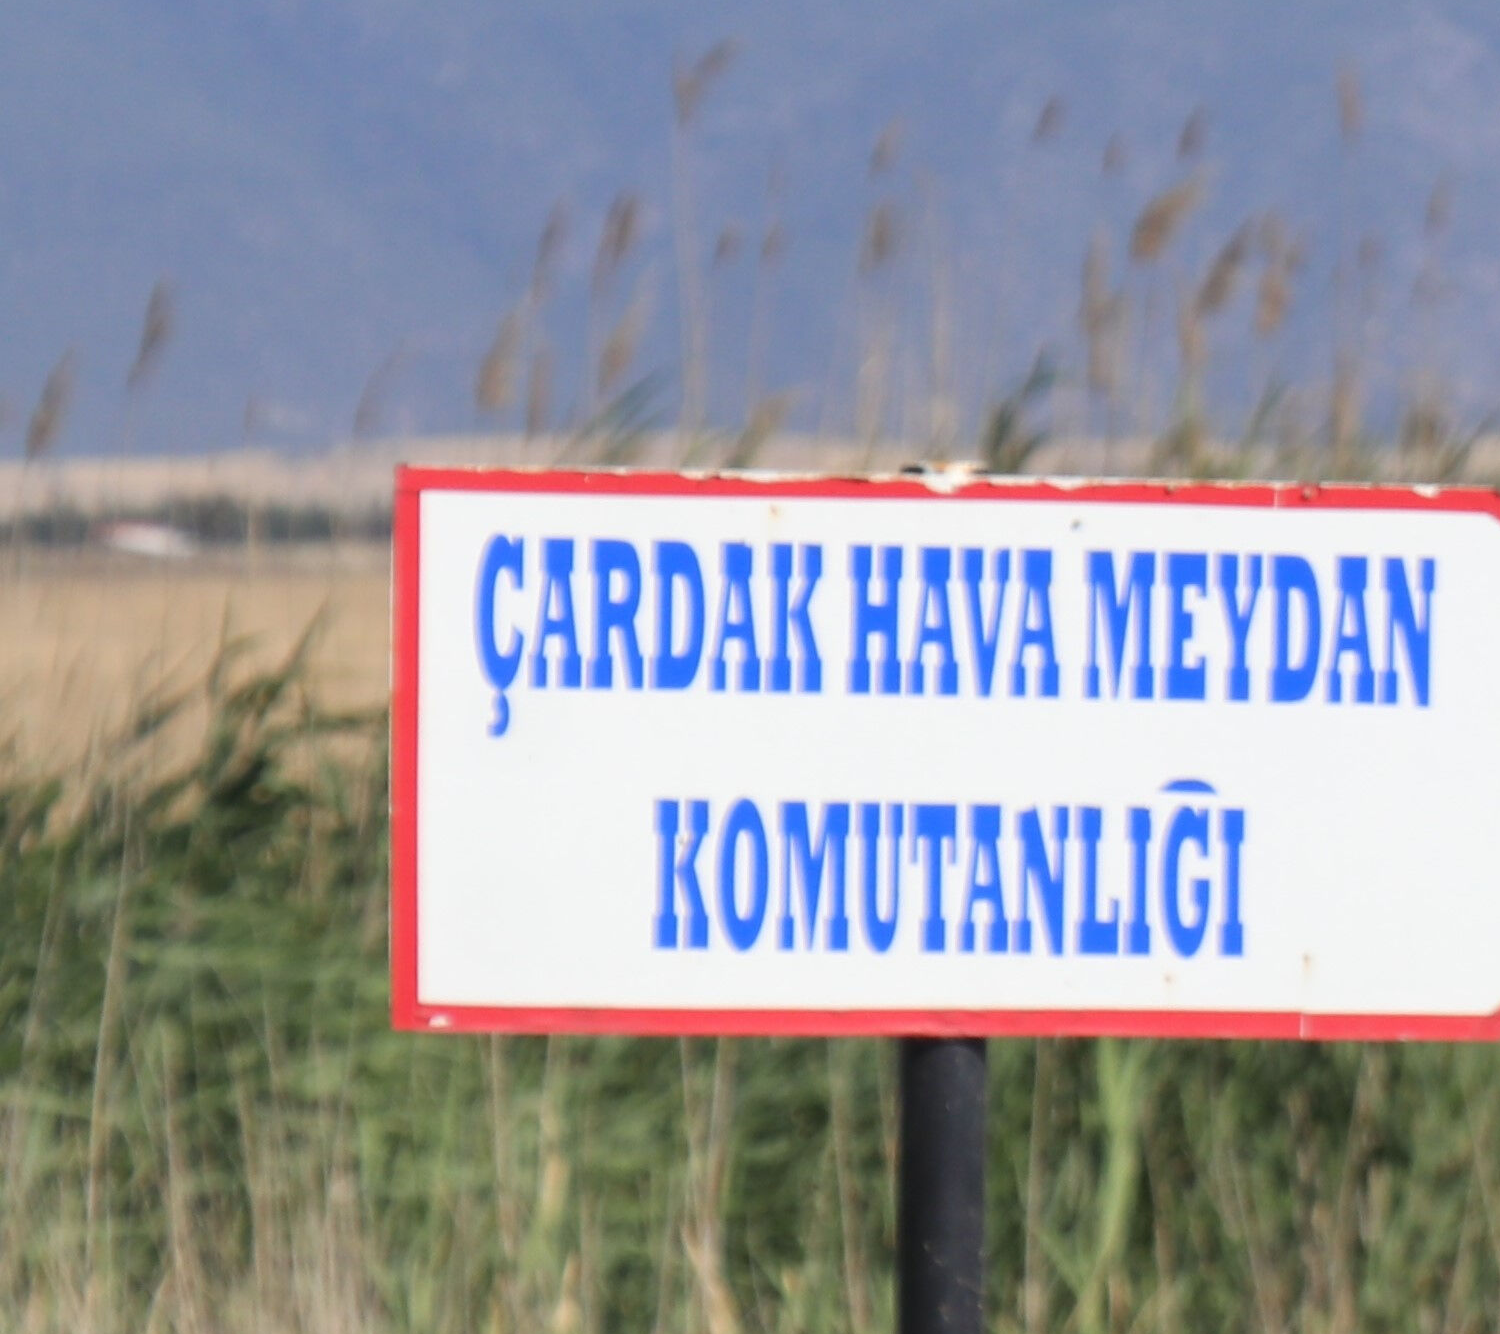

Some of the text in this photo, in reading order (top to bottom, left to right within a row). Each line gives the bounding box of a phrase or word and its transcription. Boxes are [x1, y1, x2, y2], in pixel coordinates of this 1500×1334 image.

[474, 534, 1437, 738] ÇARDAK HAVA MEYDAN
[654, 779, 1246, 959] KOMUTANLIĞI
